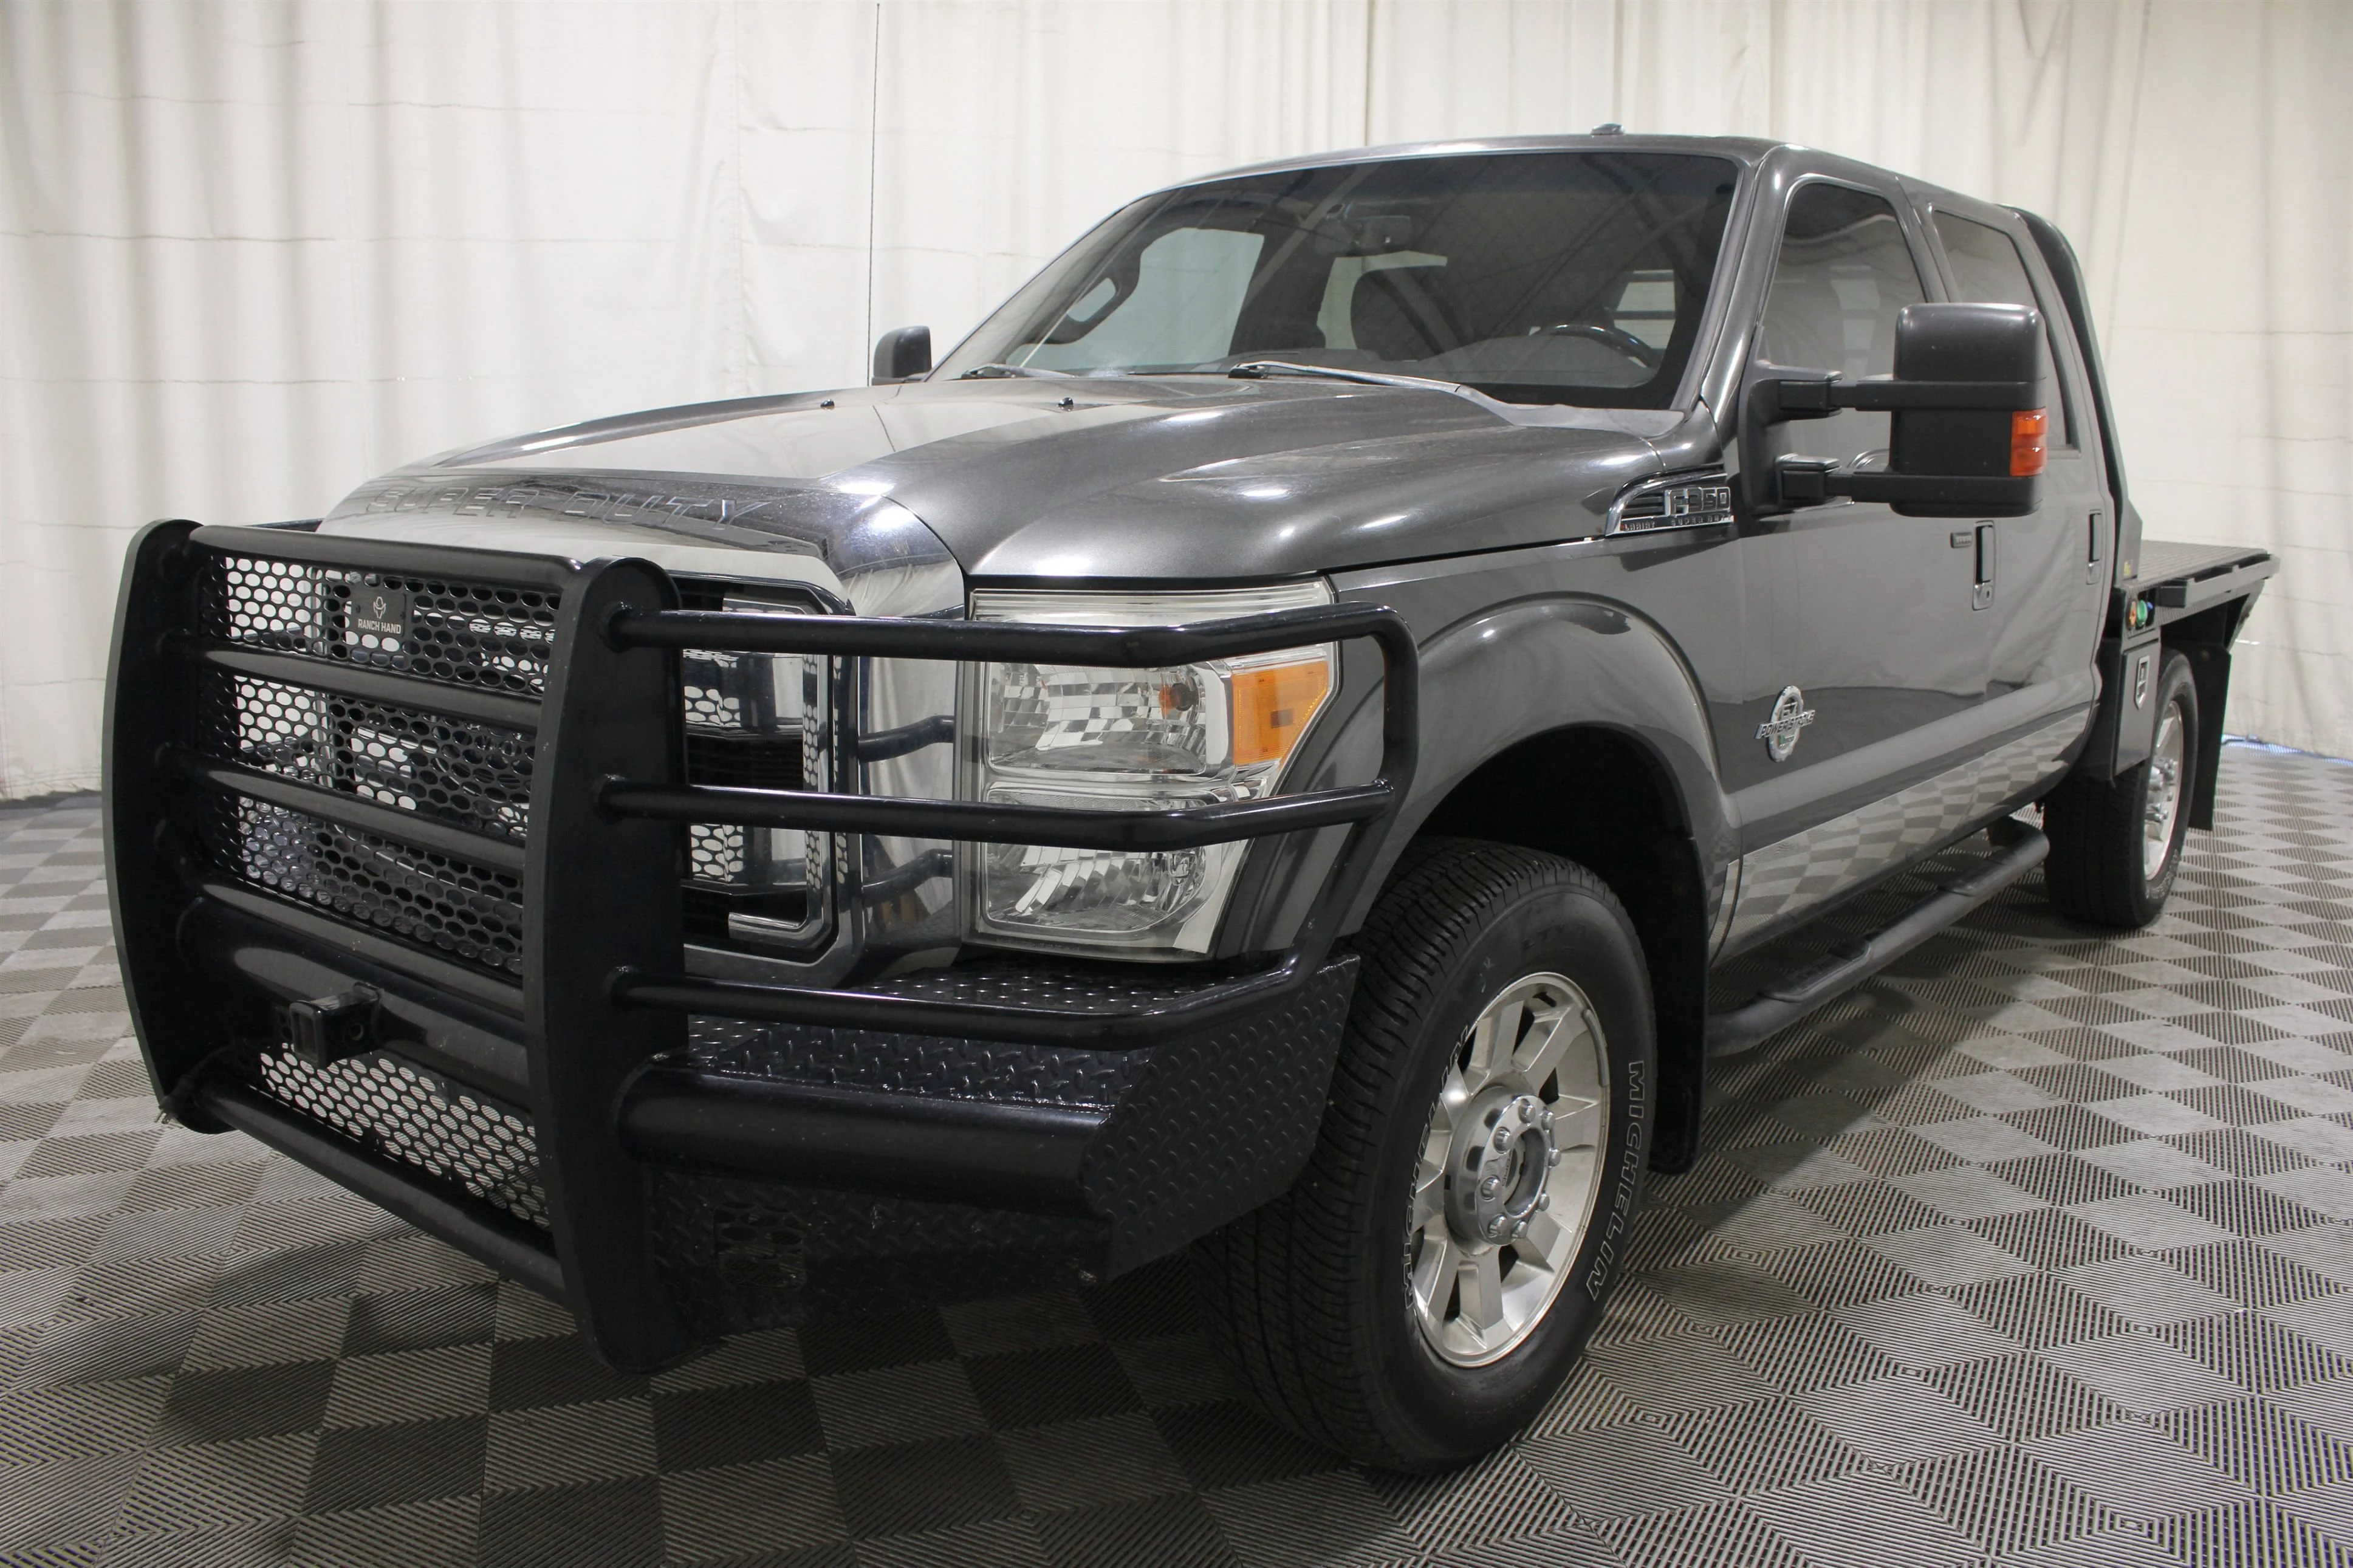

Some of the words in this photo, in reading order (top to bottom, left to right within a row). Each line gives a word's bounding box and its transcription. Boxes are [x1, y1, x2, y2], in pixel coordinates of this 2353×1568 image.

[365, 487, 541, 518] SUPER
[549, 491, 772, 530] DUTY
[357, 618, 380, 632] RANCH
[380, 621, 402, 634] HAND
[1586, 1060, 1644, 1301] MICHELIN
